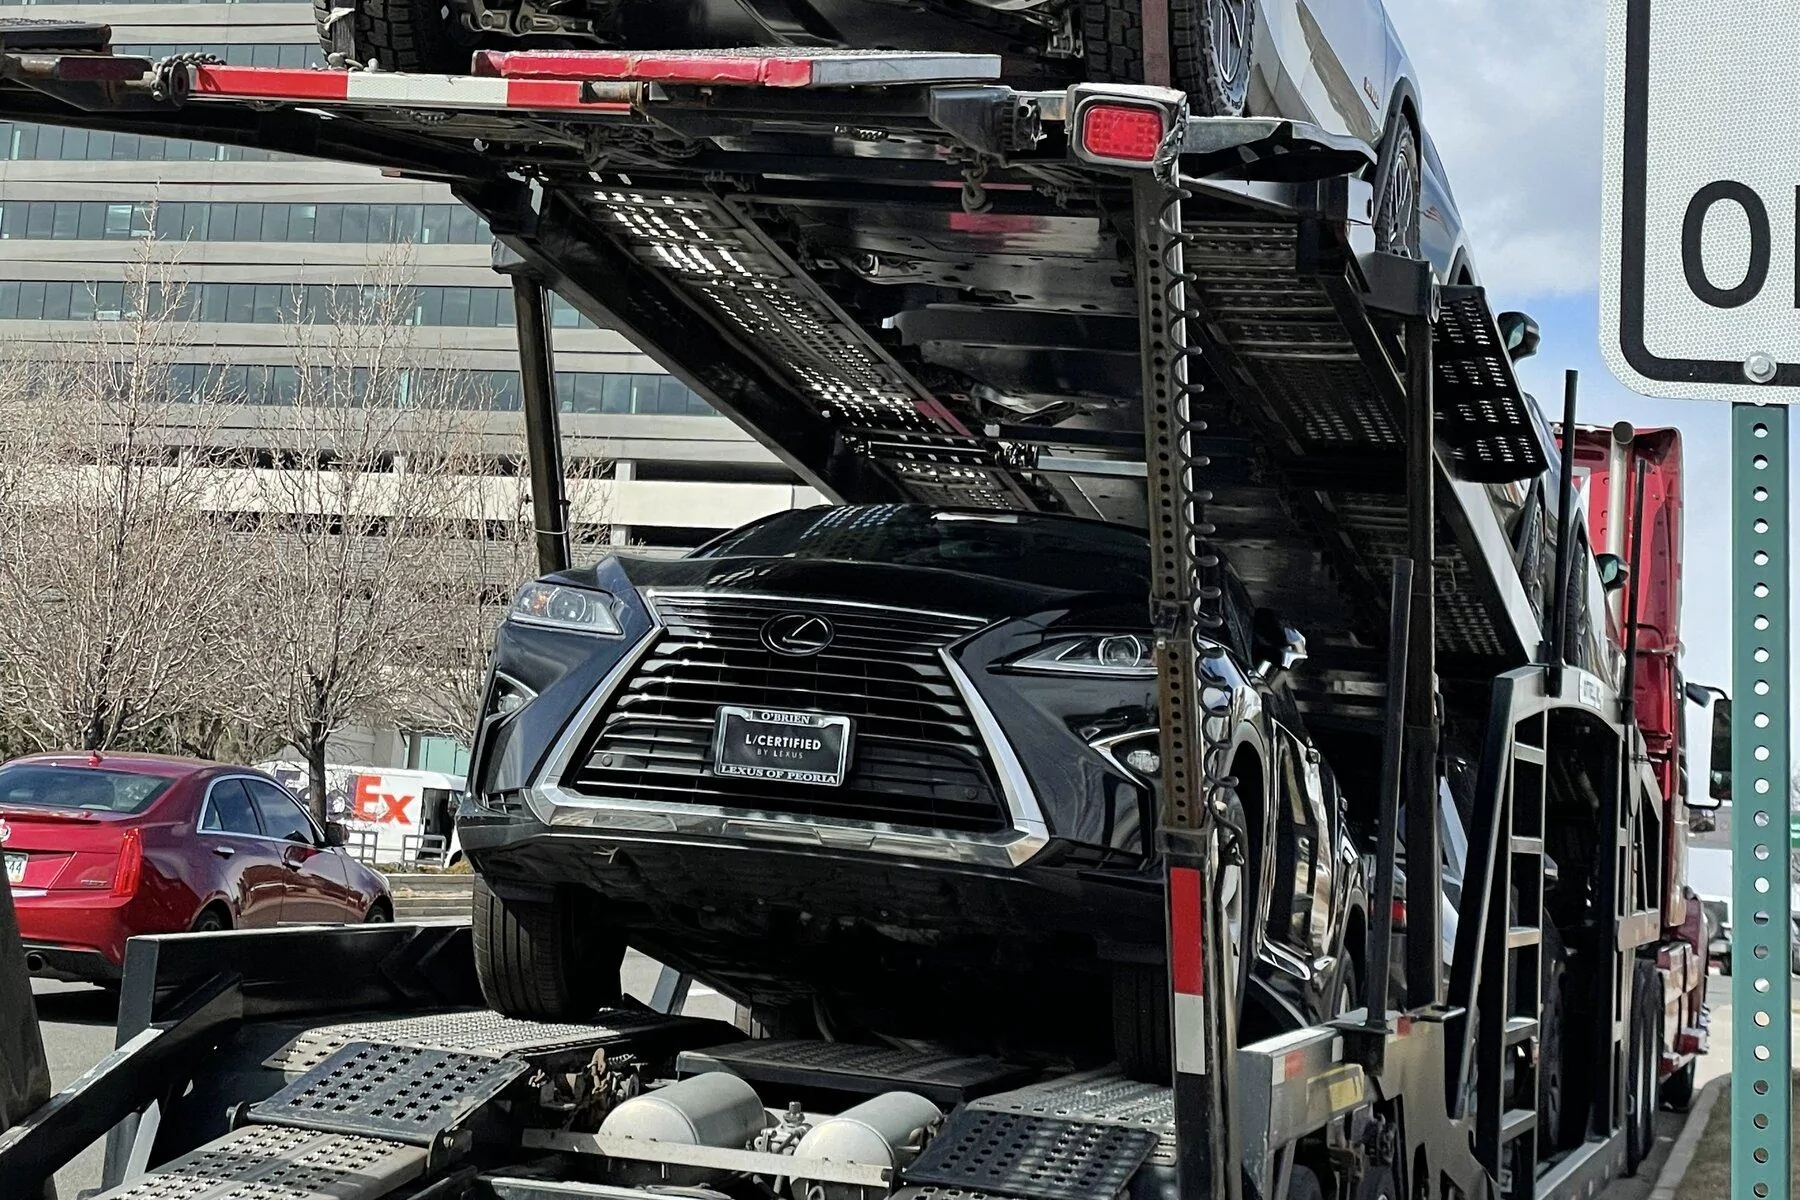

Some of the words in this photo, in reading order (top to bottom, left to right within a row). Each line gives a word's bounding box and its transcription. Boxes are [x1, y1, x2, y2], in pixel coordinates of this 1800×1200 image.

[761, 711, 811, 725] O'BRIEN
[745, 733, 822, 751] L/CERTIFIED
[757, 749, 768, 757] BY
[773, 750, 804, 759] LEXUS
[720, 764, 764, 777] LEXUS
[766, 769, 785, 779] OF
[787, 771, 837, 785] PEORIA
